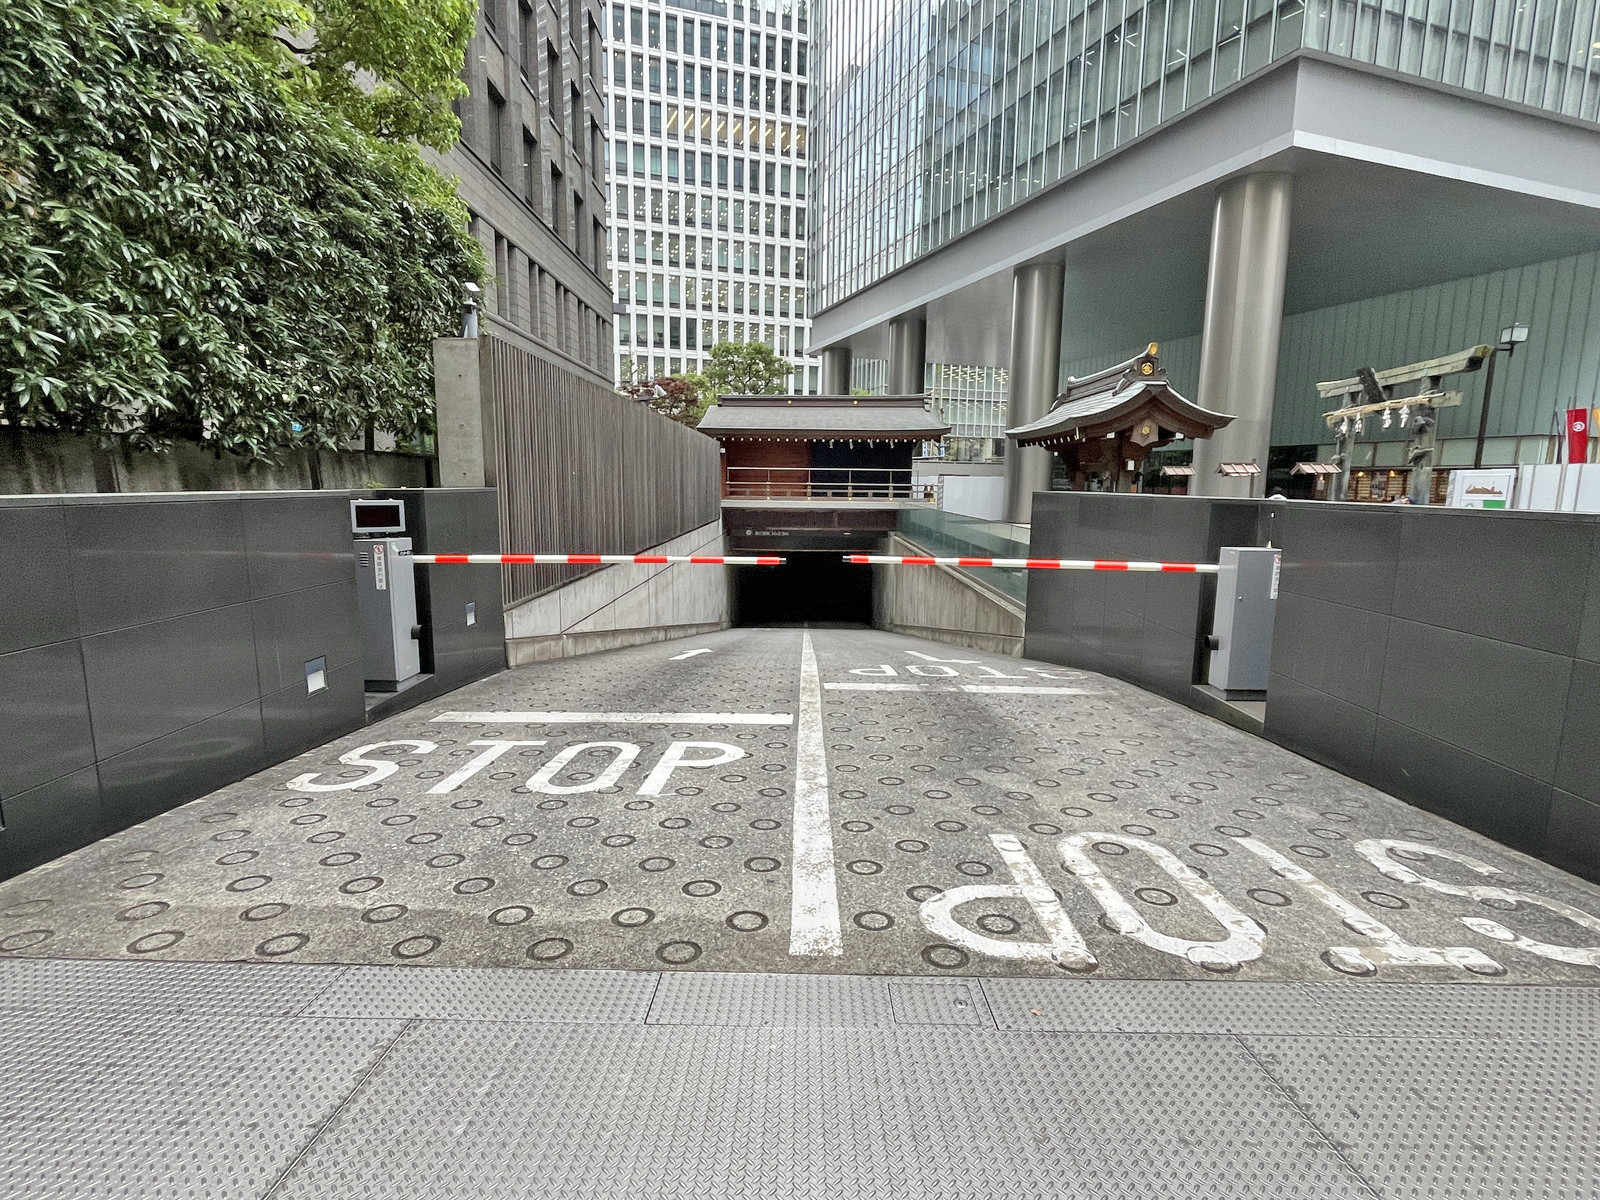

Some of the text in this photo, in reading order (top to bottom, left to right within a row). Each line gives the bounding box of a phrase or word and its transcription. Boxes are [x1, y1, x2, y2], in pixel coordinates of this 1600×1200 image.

[849, 664, 1089, 680] STOP
[286, 739, 746, 796] STOP
[919, 831, 1600, 974] STOP
